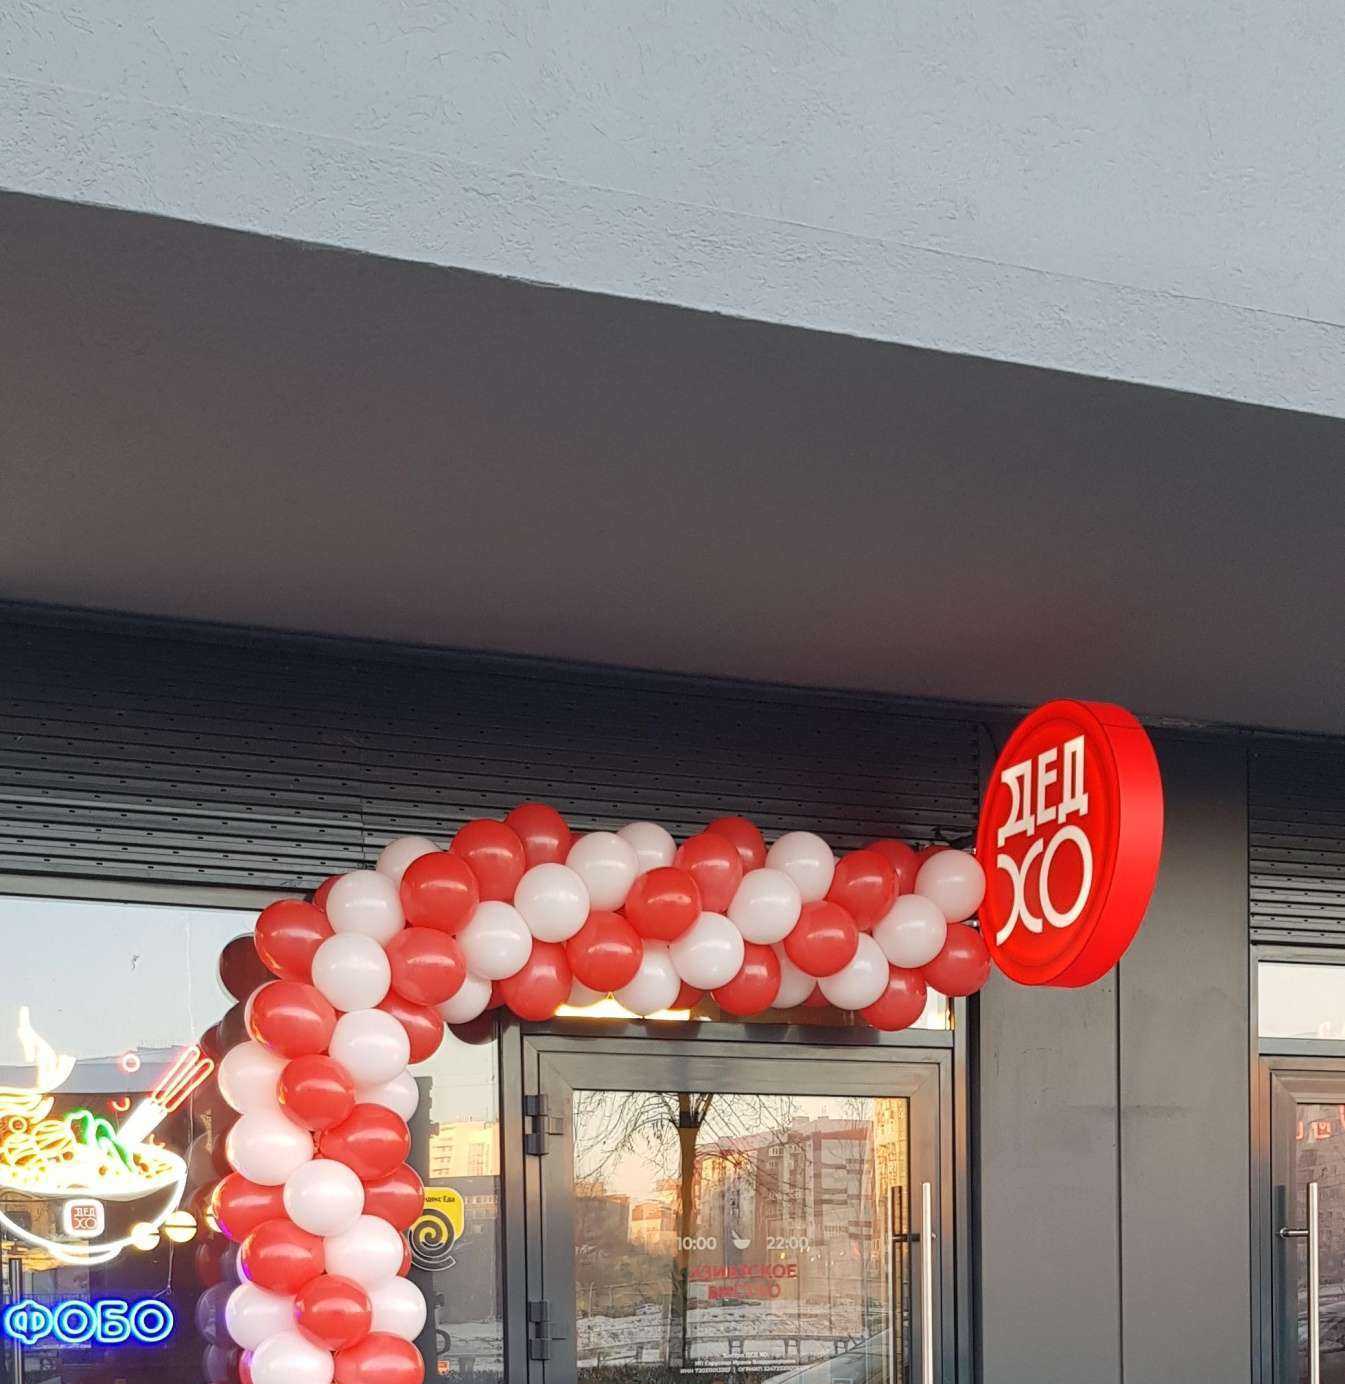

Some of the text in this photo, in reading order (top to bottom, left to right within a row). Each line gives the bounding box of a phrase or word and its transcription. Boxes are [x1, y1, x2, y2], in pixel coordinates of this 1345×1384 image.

[997, 734, 1089, 849] ДЕД
[996, 824, 1093, 947] ХО
[677, 1236, 809, 1250] 10:00 22:00
[5, 1299, 175, 1345] ФОБО
